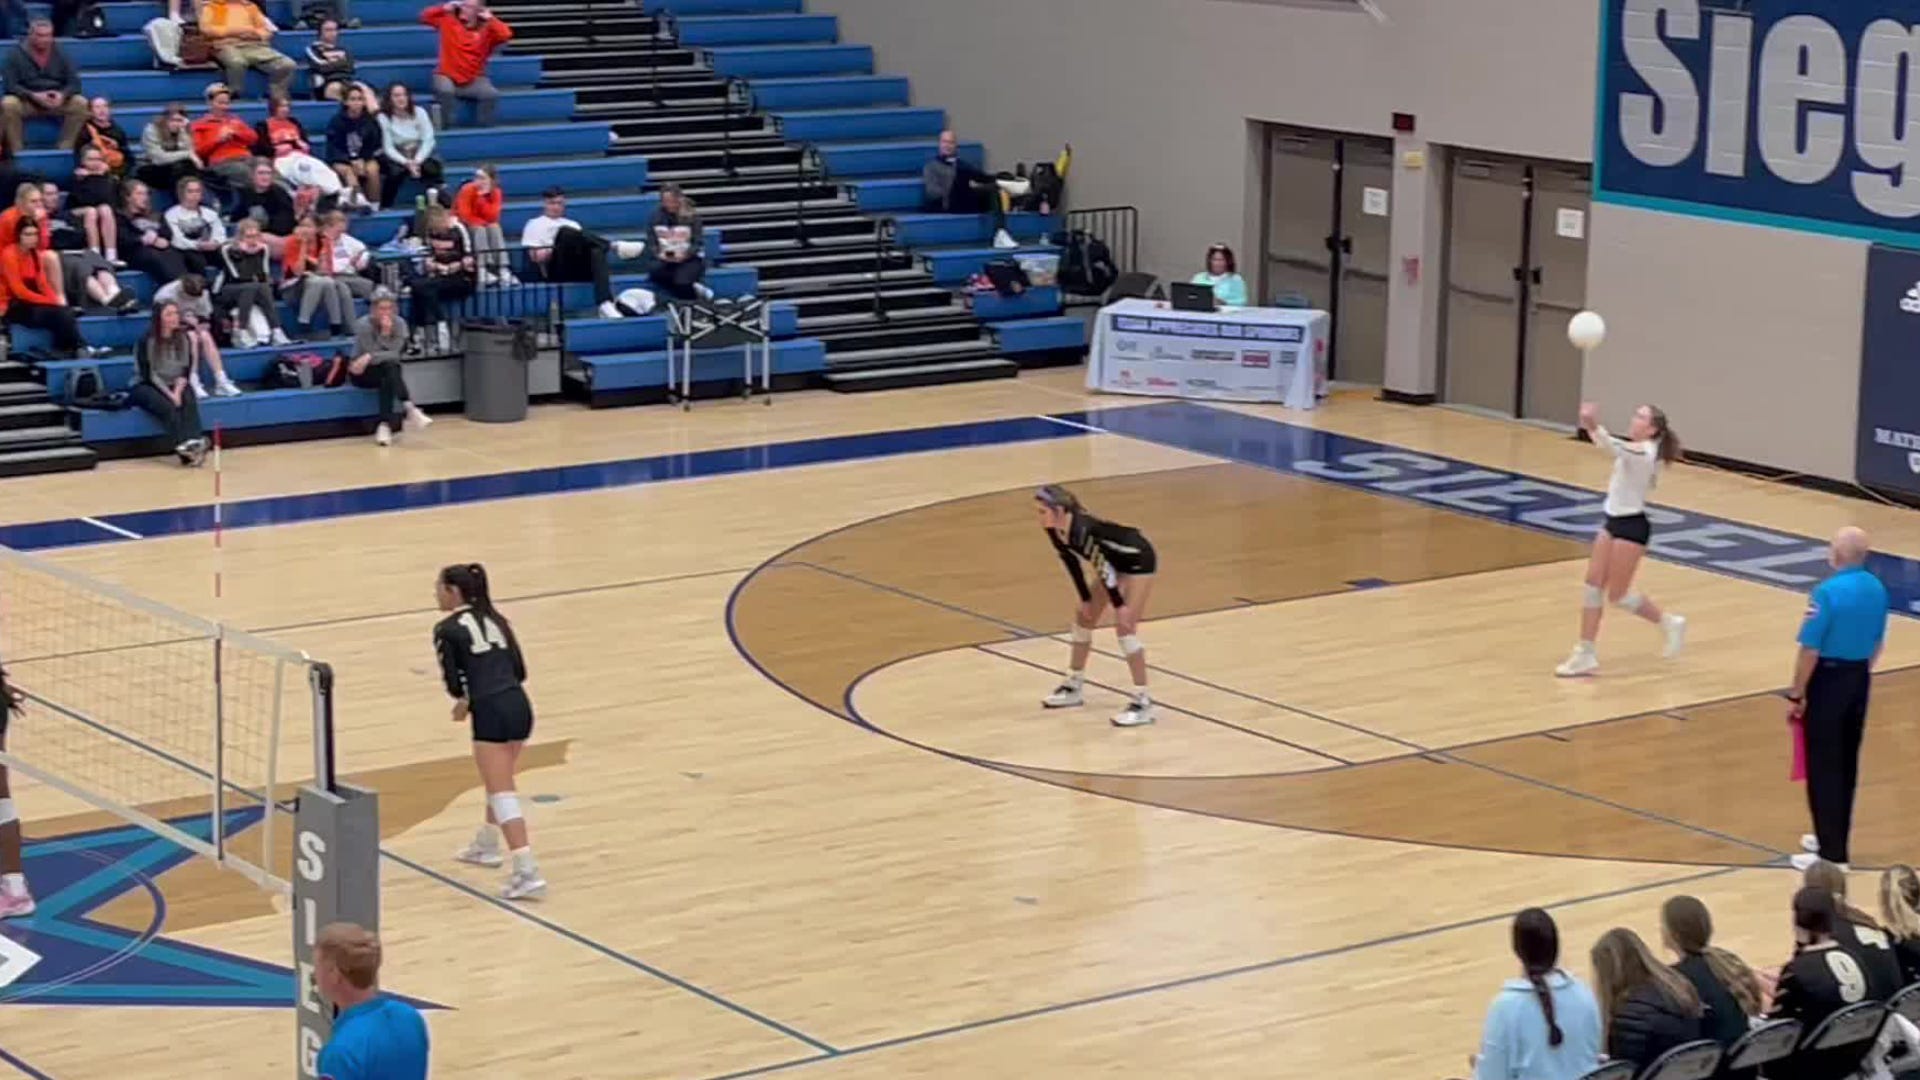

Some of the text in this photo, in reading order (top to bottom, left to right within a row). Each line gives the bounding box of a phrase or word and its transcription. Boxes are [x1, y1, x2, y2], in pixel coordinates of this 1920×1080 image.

[1619, 0, 1920, 218] Sieg
[457, 611, 508, 654] 14
[1825, 950, 1866, 1002] 9
